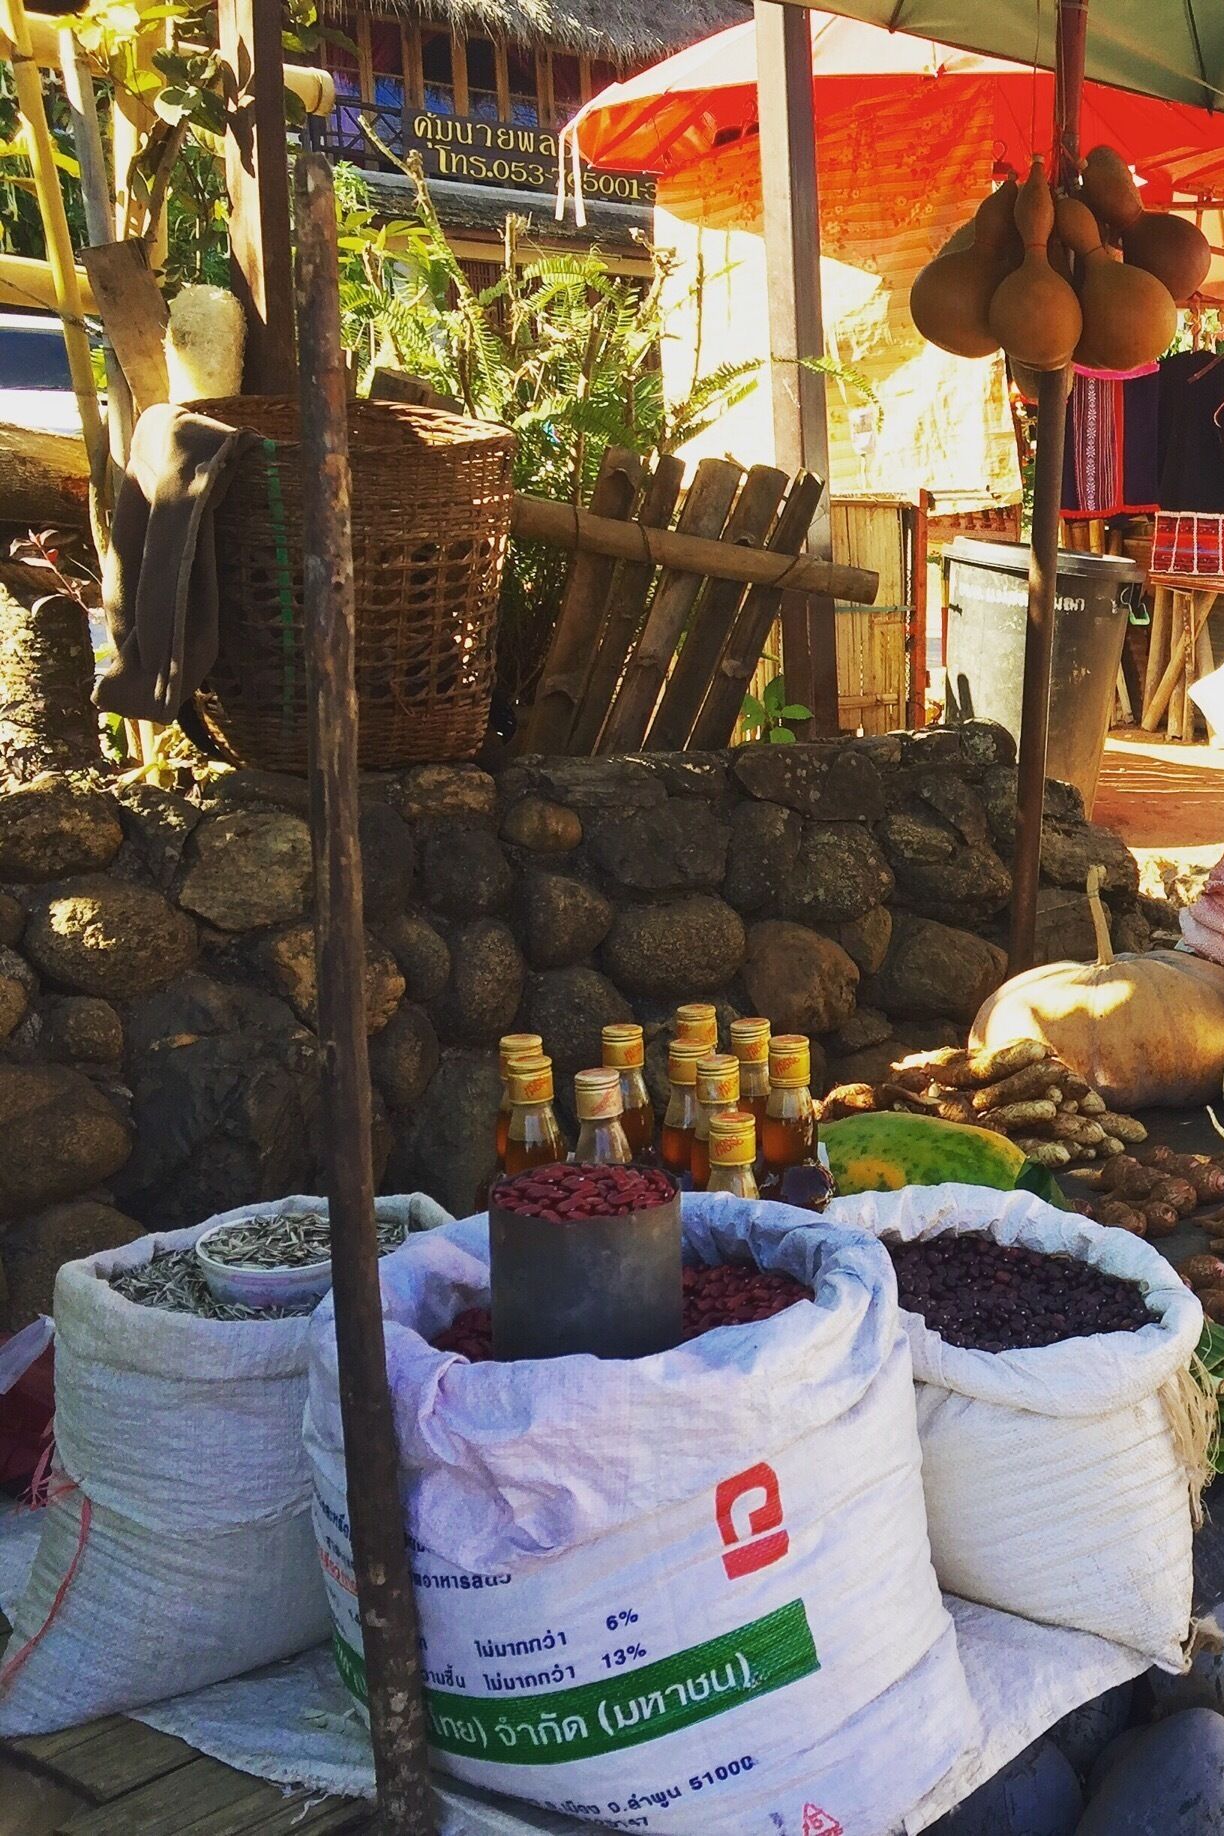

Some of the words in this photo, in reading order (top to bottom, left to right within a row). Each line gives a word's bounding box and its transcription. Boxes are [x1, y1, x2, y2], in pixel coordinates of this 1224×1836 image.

[473, 1629, 567, 1658] ไม่มากกว่า
[605, 1608, 639, 1631] 6%
[420, 1663, 467, 1689] วามชื้น
[482, 1663, 576, 1691] ไม่มากกว่า
[601, 1643, 647, 1669] 13%
[494, 1712, 589, 1747] จำกัด
[597, 1652, 752, 1737] (มหาชน)
[688, 1755, 755, 1791] 51000
